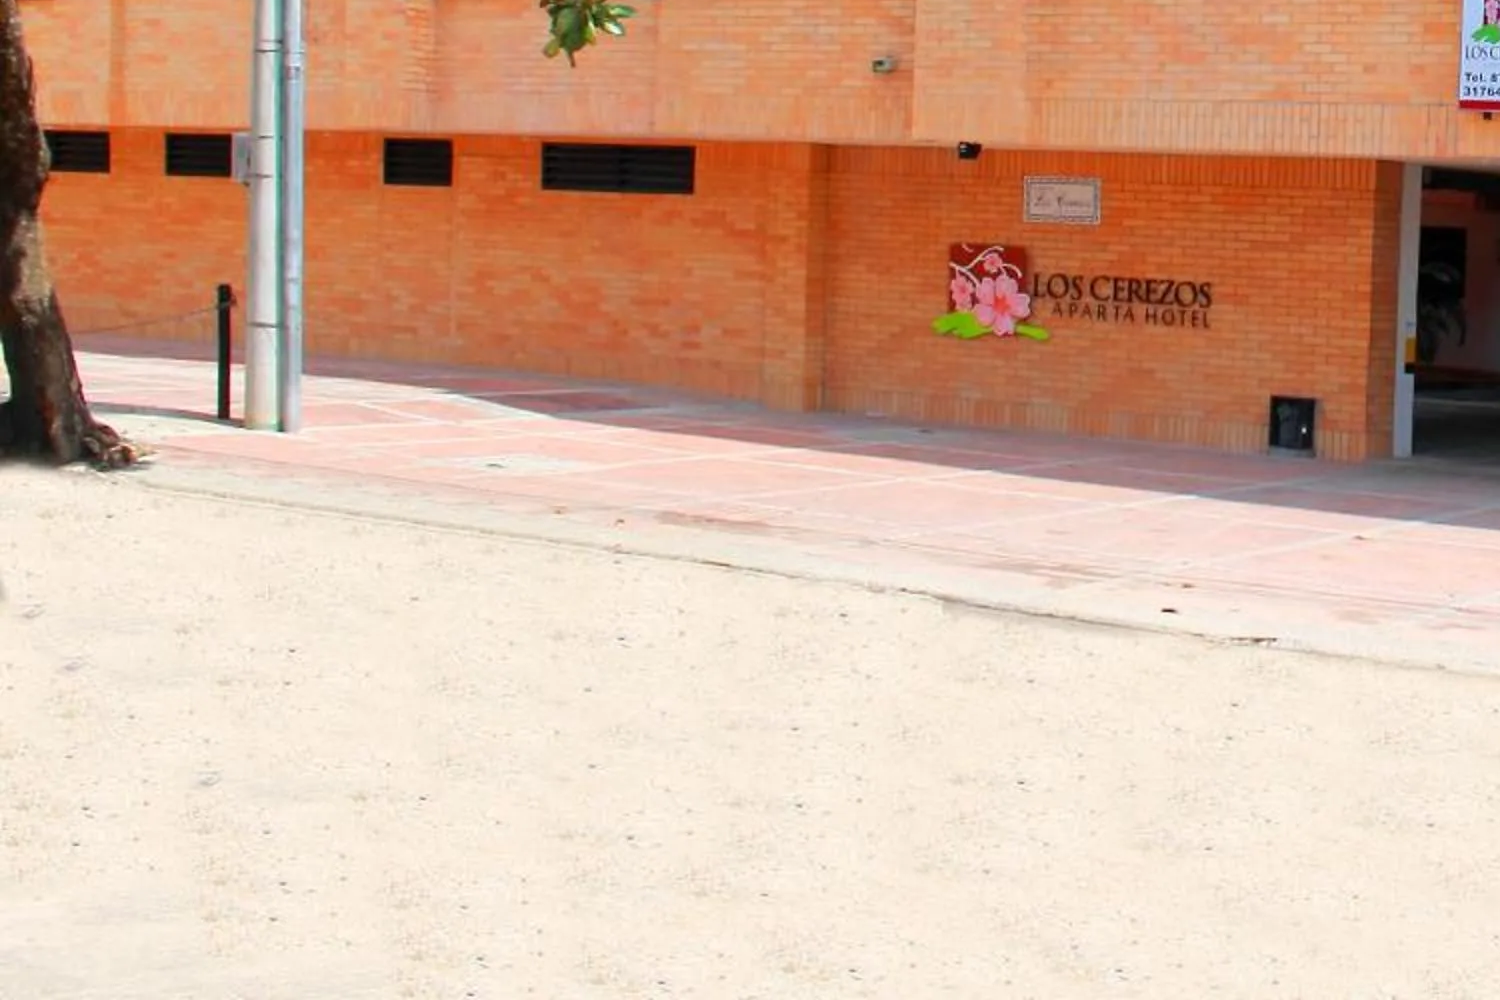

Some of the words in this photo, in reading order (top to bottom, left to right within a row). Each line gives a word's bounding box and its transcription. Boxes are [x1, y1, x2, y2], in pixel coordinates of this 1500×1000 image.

[1465, 45, 1488, 60] LOS
[1033, 273, 1084, 300] LOS
[1090, 275, 1212, 308] CEREZOS
[1053, 302, 1135, 323] APARTA
[1144, 309, 1211, 328] HOTEL
